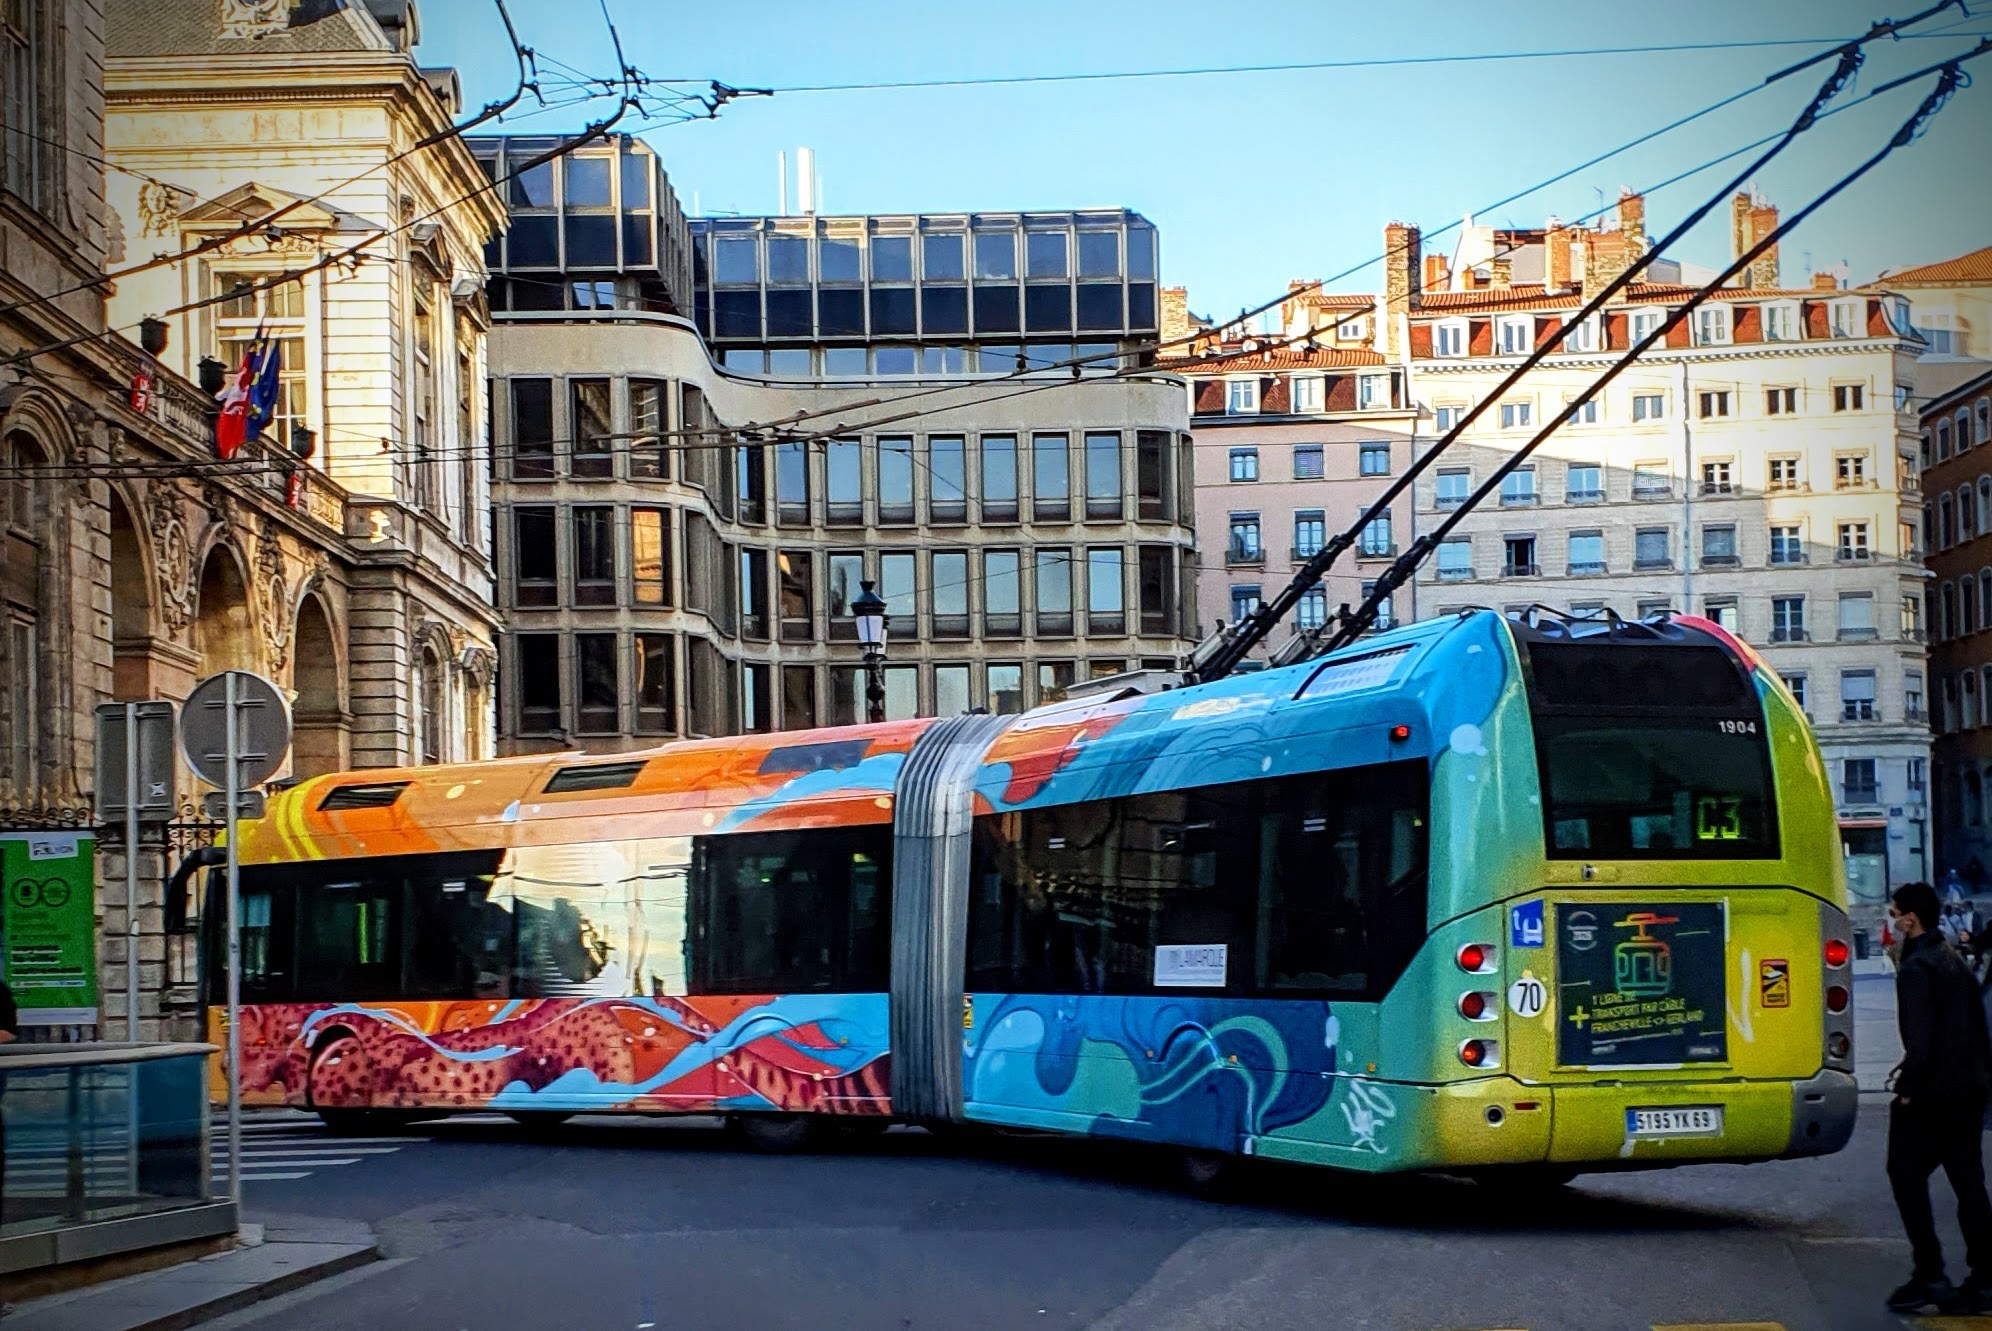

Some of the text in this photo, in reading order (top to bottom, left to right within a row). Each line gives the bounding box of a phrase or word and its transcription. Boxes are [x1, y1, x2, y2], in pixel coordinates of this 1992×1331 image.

[1718, 720, 1756, 734] 1904
[1698, 798, 1740, 839] C3
[1517, 982, 1540, 1013] 70
[1638, 1112, 1670, 1129] 5195
[1693, 1111, 1709, 1128] 69
